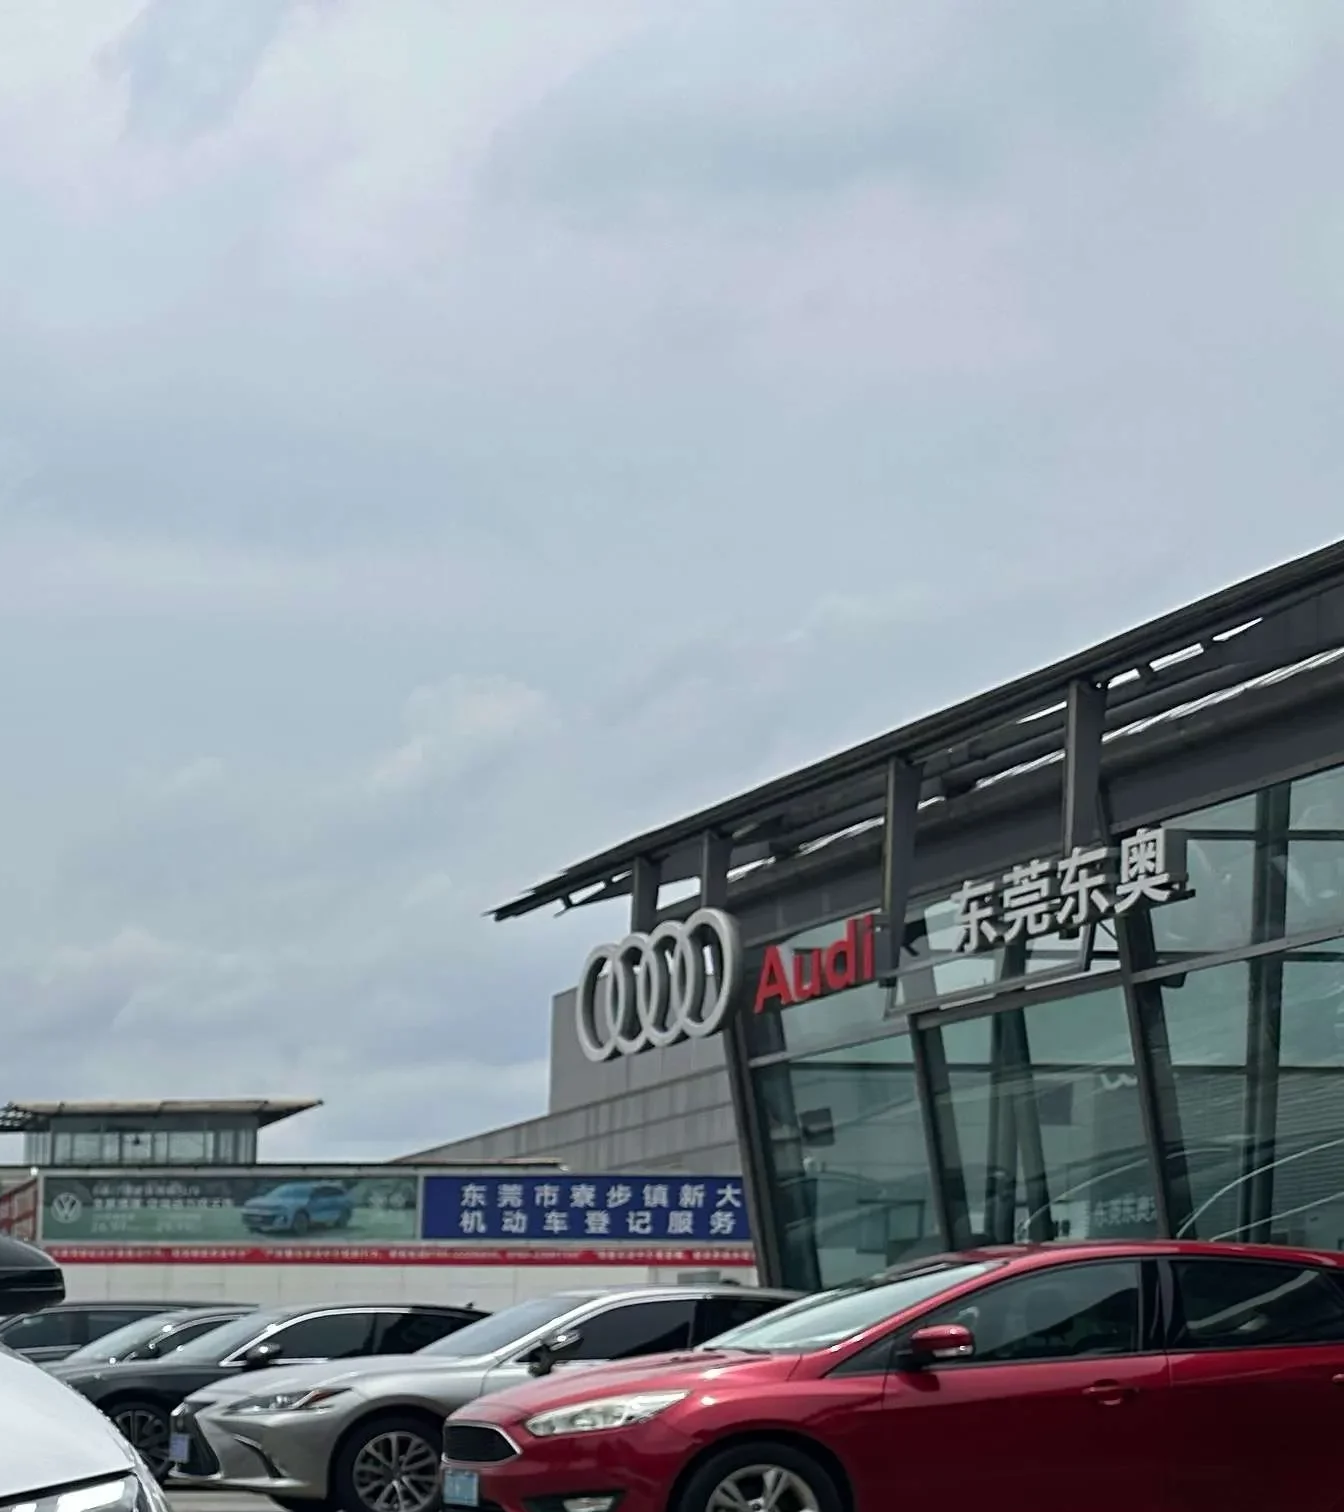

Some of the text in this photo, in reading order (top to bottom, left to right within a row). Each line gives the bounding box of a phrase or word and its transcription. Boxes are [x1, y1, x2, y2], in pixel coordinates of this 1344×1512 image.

[950, 828, 1171, 954] 东莞东奥
[753, 914, 876, 1014] Audi
[459, 1211, 737, 1235] 机动车登记服务
[460, 1183, 742, 1208] 东莞市寮步镇新大
